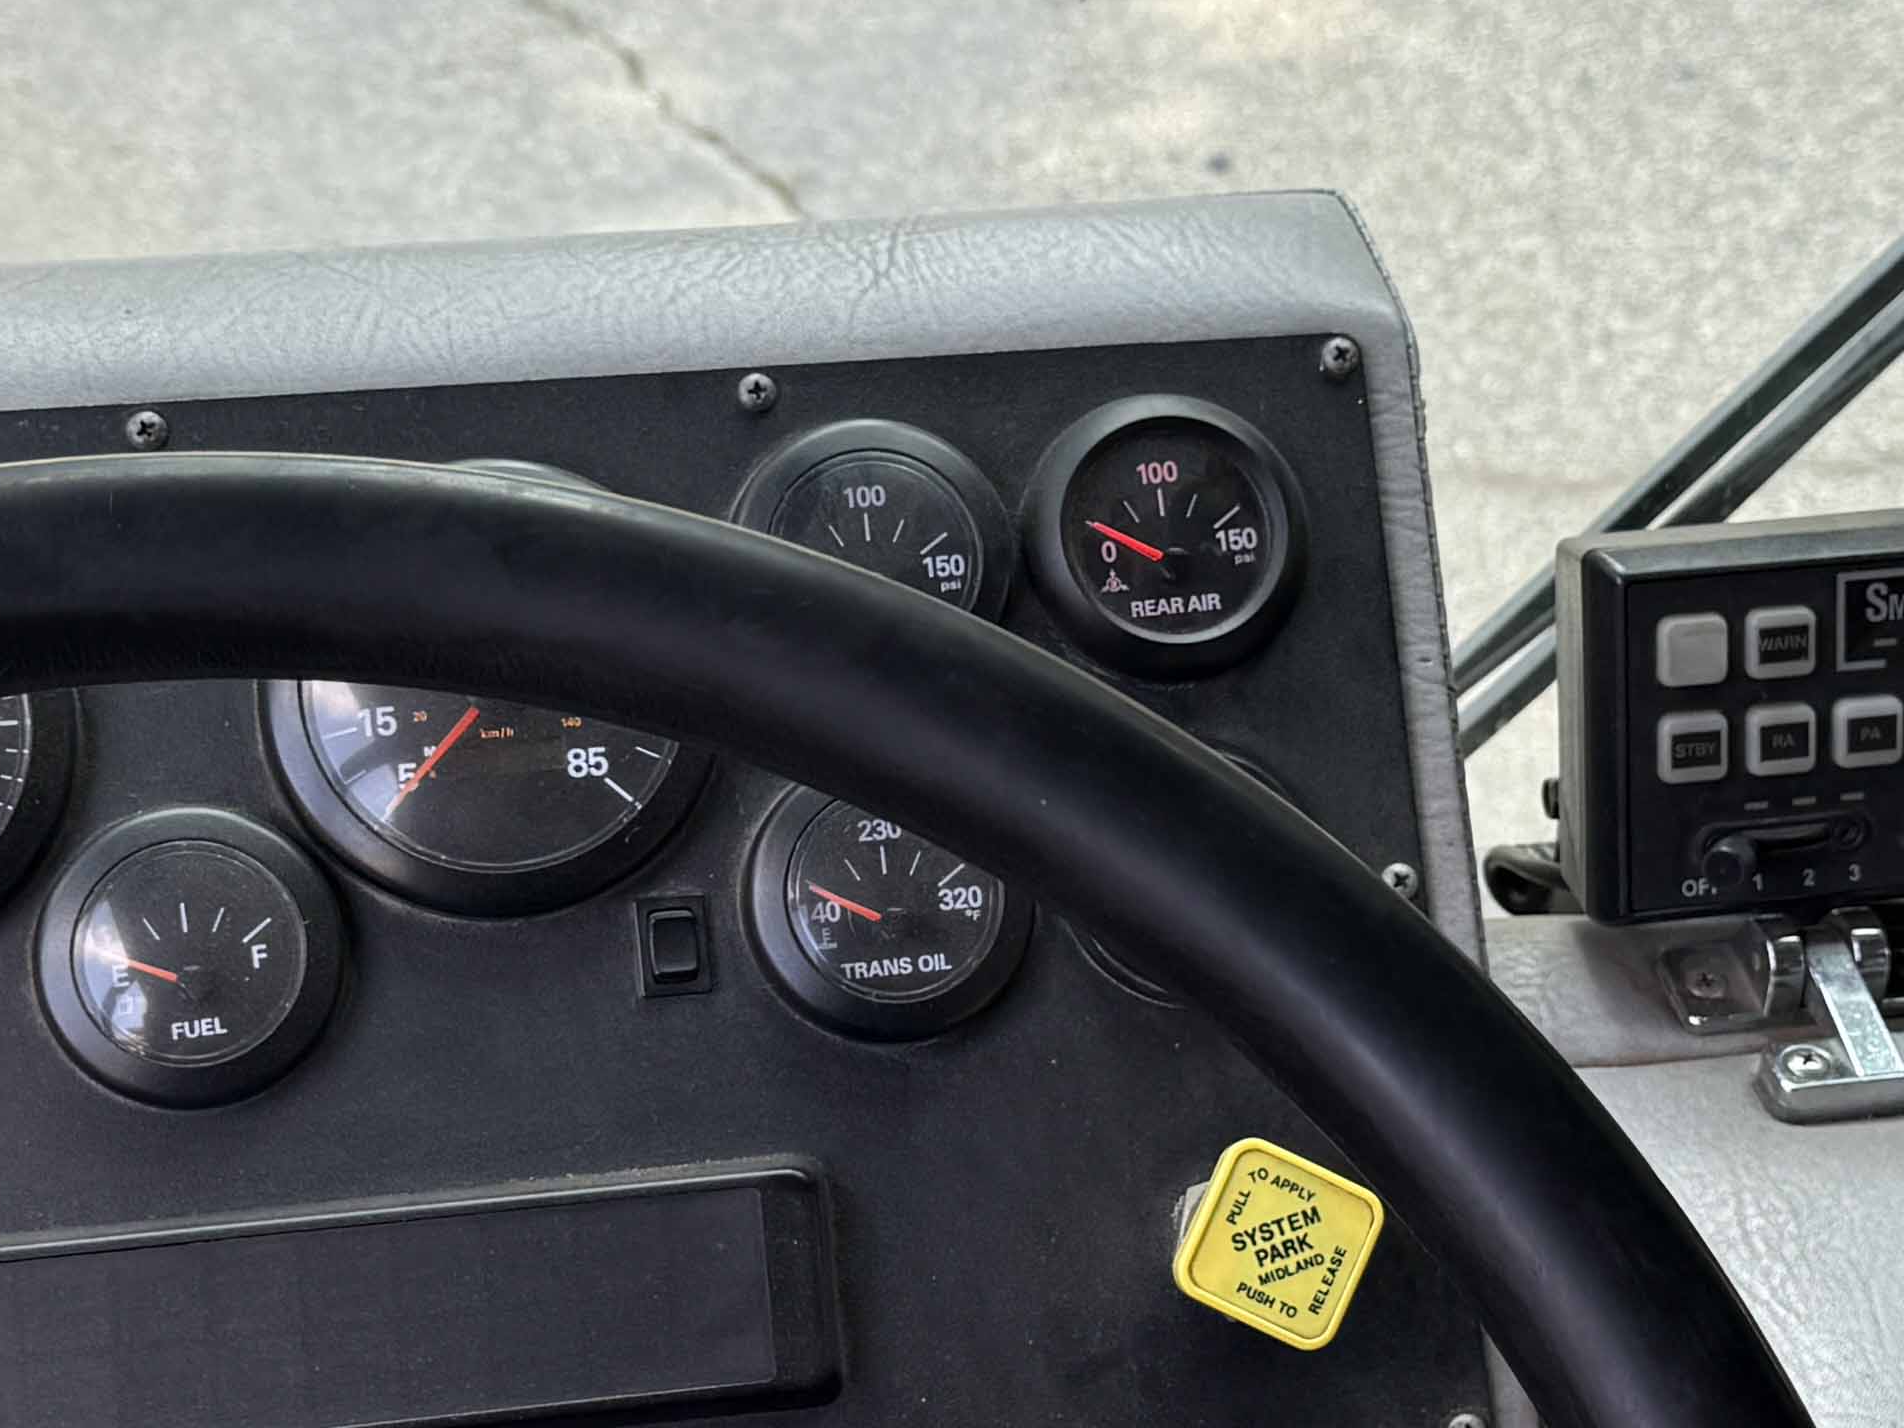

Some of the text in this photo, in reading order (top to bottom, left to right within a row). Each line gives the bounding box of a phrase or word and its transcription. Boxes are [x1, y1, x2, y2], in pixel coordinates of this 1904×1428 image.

[1136, 460, 1178, 484] 100
[843, 484, 886, 508] 100
[1101, 541, 1117, 562] 0
[1215, 527, 1257, 552] 150
[922, 554, 965, 578] 150
[940, 579, 962, 592] psi
[1130, 593, 1222, 618] REAR AIR
[357, 706, 398, 737] 15
[567, 746, 609, 778] 85
[1752, 873, 1764, 891] 1
[1802, 868, 1816, 887] 2
[1849, 863, 1862, 882] 3
[938, 885, 983, 911] 320
[1681, 876, 1718, 898] OF
[810, 901, 841, 923] 40
[251, 943, 268, 968] F
[840, 953, 953, 980] TRANS OIL
[171, 1017, 228, 1040] FUEL
[1227, 1167, 1316, 1225] PULL TO APPLY
[1231, 1205, 1322, 1251] SYSTEM
[1254, 1232, 1314, 1268] PARK
[1258, 1252, 1325, 1286] MIDLAND
[1236, 1245, 1347, 1319] PUSH TO RELEASE
